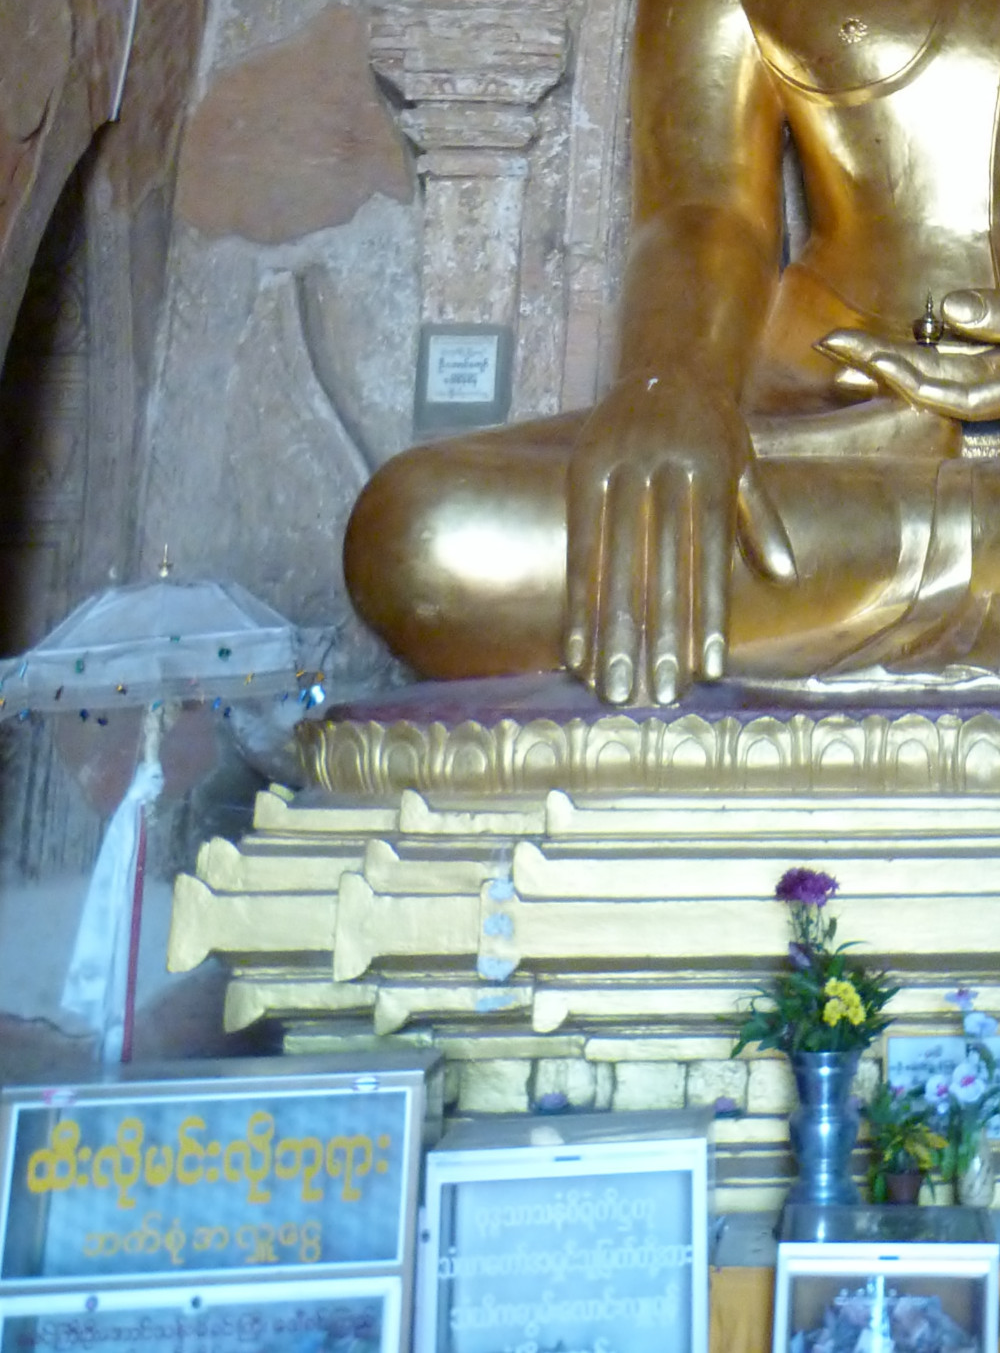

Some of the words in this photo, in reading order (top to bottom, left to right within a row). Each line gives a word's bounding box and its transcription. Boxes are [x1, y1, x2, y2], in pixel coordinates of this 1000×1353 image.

[28, 1110, 391, 1209] ထီးလိုမင်းလိုဘုရား
